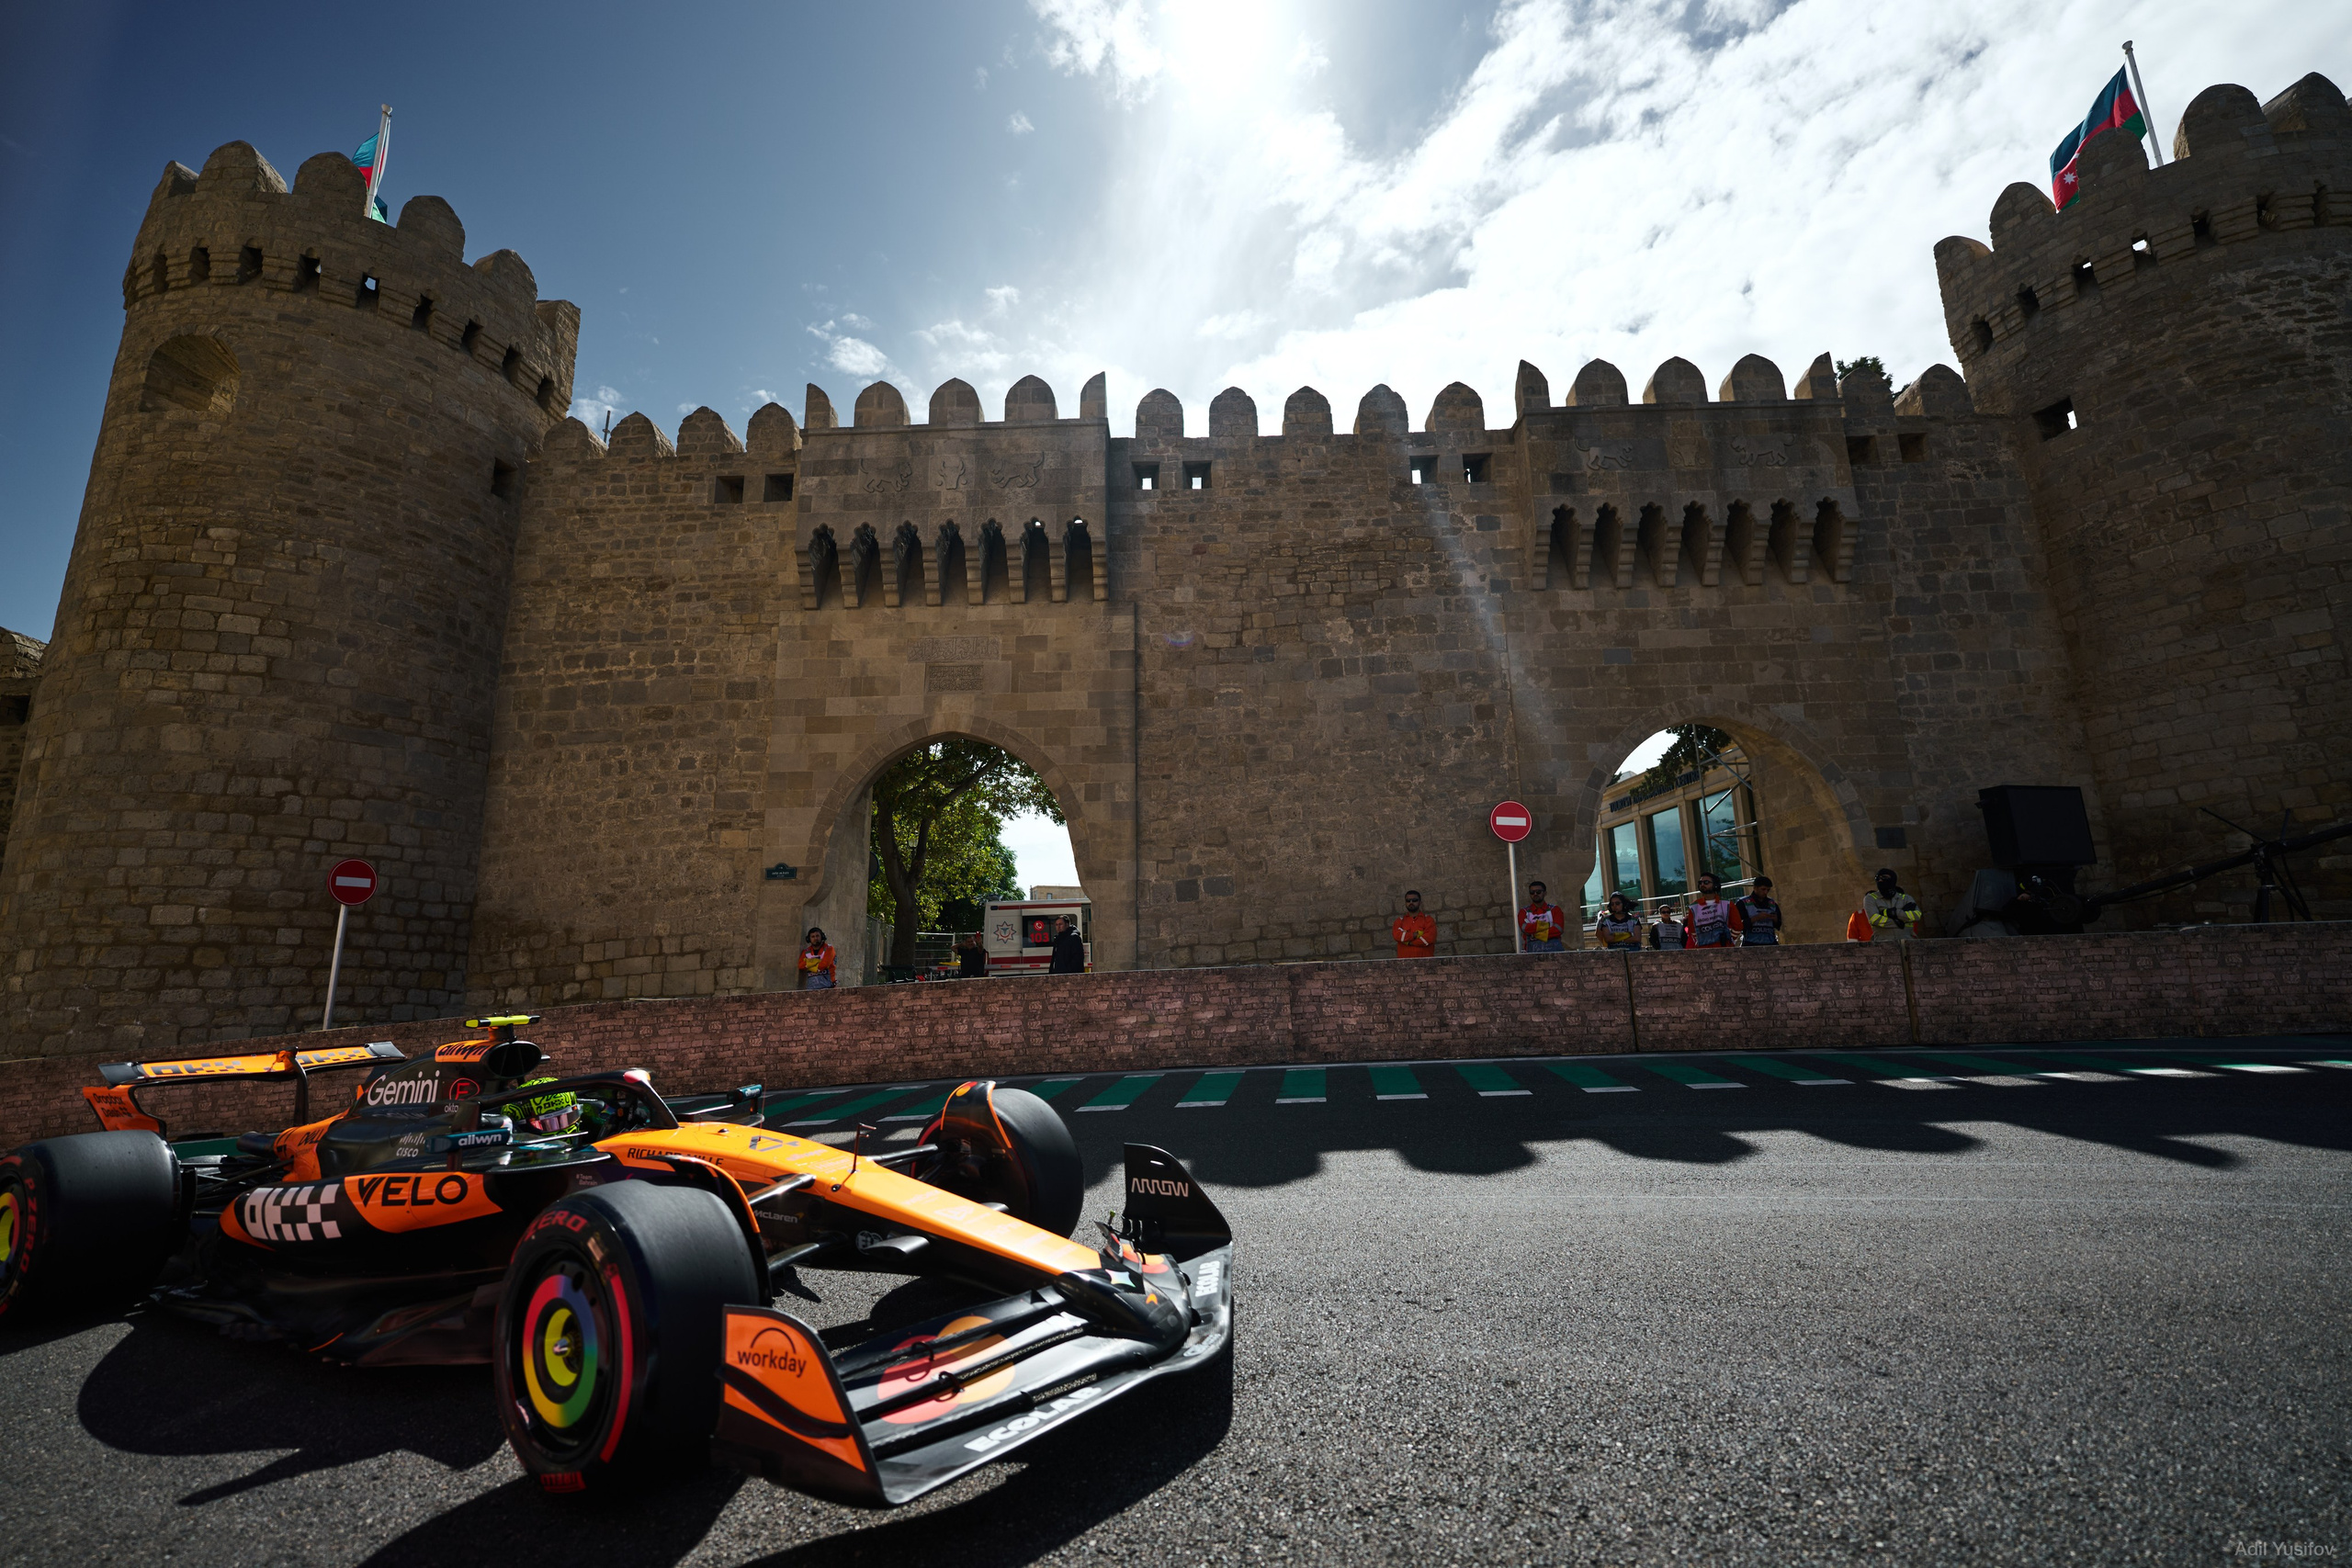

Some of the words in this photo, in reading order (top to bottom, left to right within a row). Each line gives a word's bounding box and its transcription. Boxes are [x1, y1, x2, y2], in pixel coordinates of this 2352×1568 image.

[1030, 932, 1050, 943] 103
[437, 1044, 490, 1060] allwyn
[368, 1069, 440, 1106] Gemini
[93, 1093, 124, 1105] Dropbox
[101, 1107, 123, 1118] Dash
[458, 1132, 503, 1146] allwyn
[24, 1177, 36, 1190] P
[357, 1174, 469, 1208] VELO
[1131, 1177, 1189, 1198] ARROW
[752, 1209, 798, 1224] McLaren
[20, 1196, 38, 1273] ZERO
[1194, 1259, 1221, 1298] ECOLAB
[737, 1348, 808, 1378] workday
[963, 1386, 1102, 1453] ECOLAB
